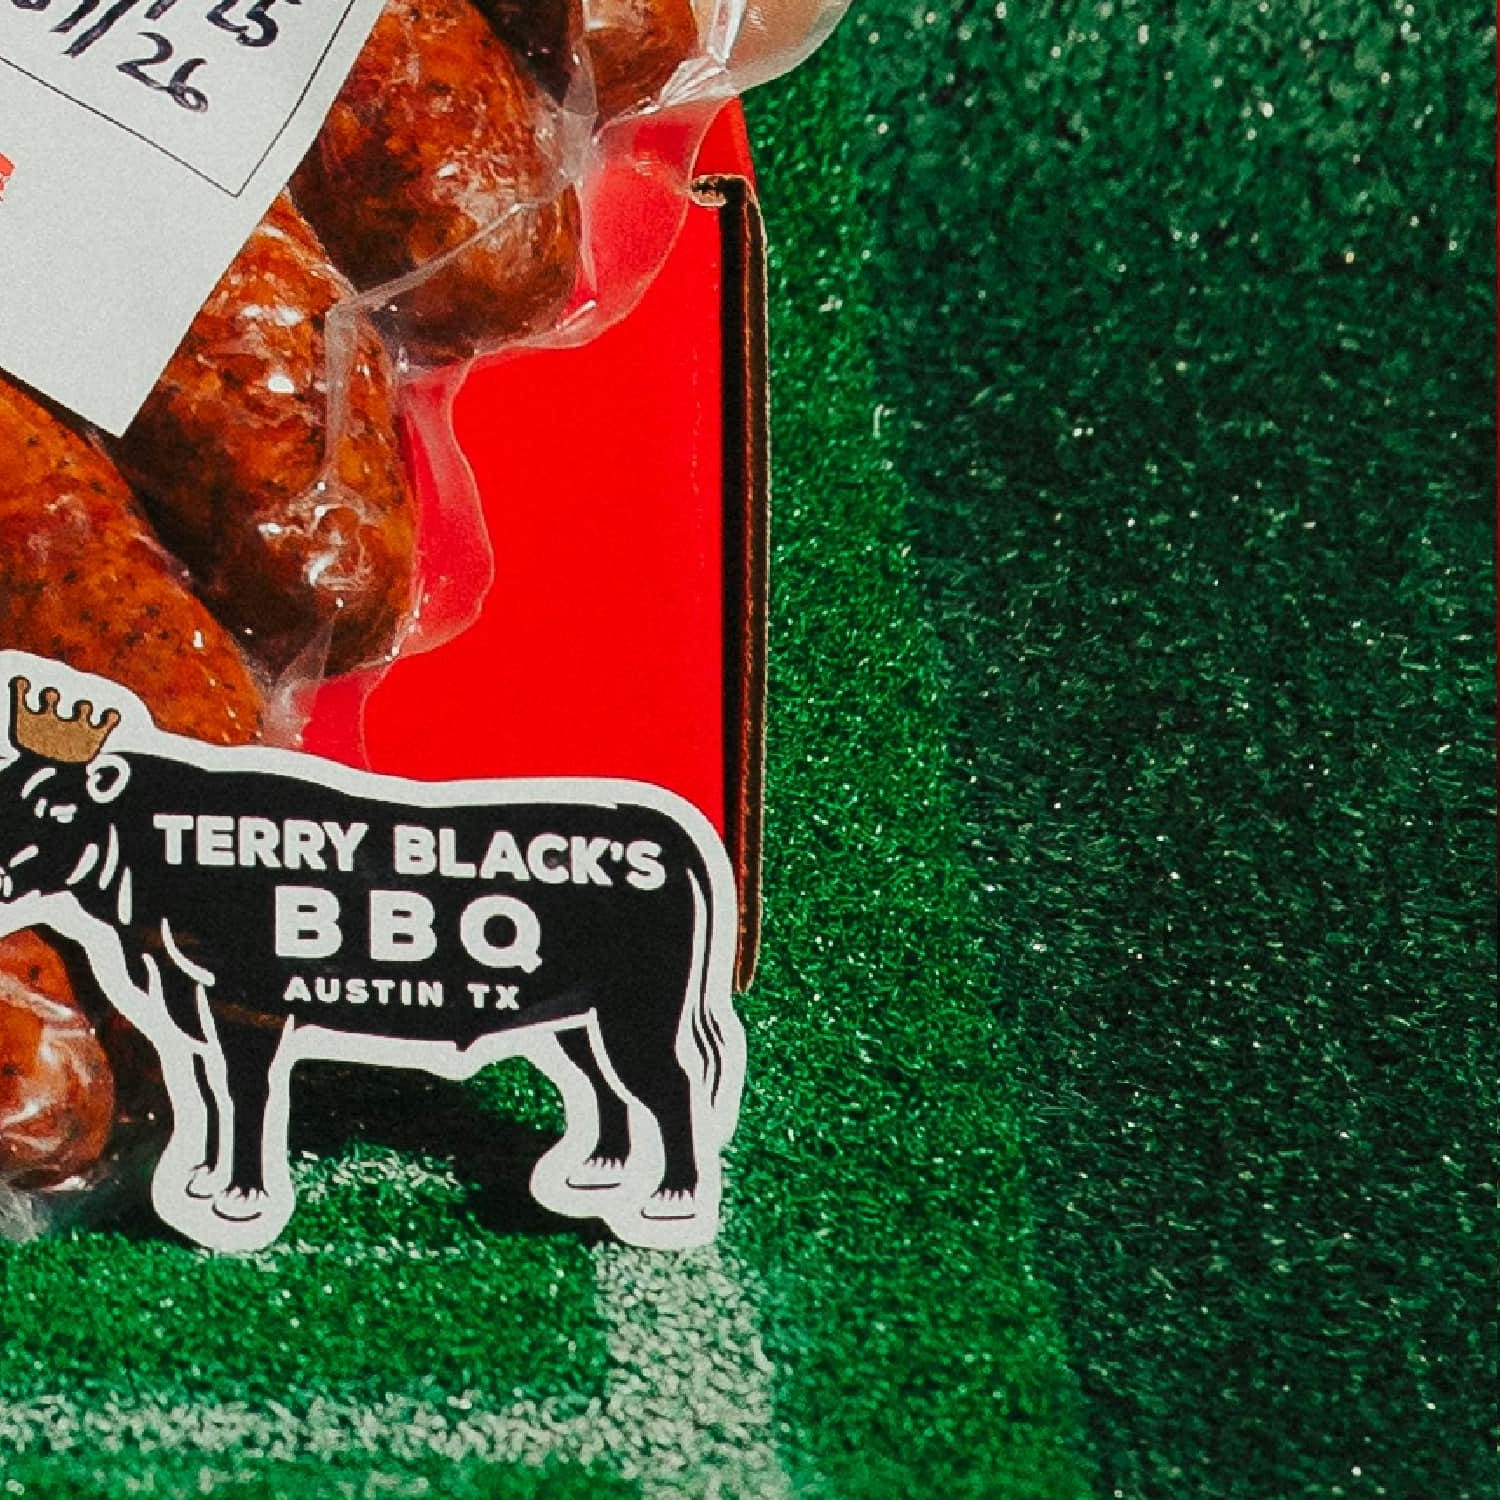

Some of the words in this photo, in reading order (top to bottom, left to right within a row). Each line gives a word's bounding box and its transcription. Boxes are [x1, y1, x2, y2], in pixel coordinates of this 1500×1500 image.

[152, 814, 370, 873] TERRY
[394, 825, 667, 891] BLACK'S
[273, 884, 544, 974] BBQ
[283, 975, 445, 1009] AUSTIN
[467, 983, 522, 1011] TX
